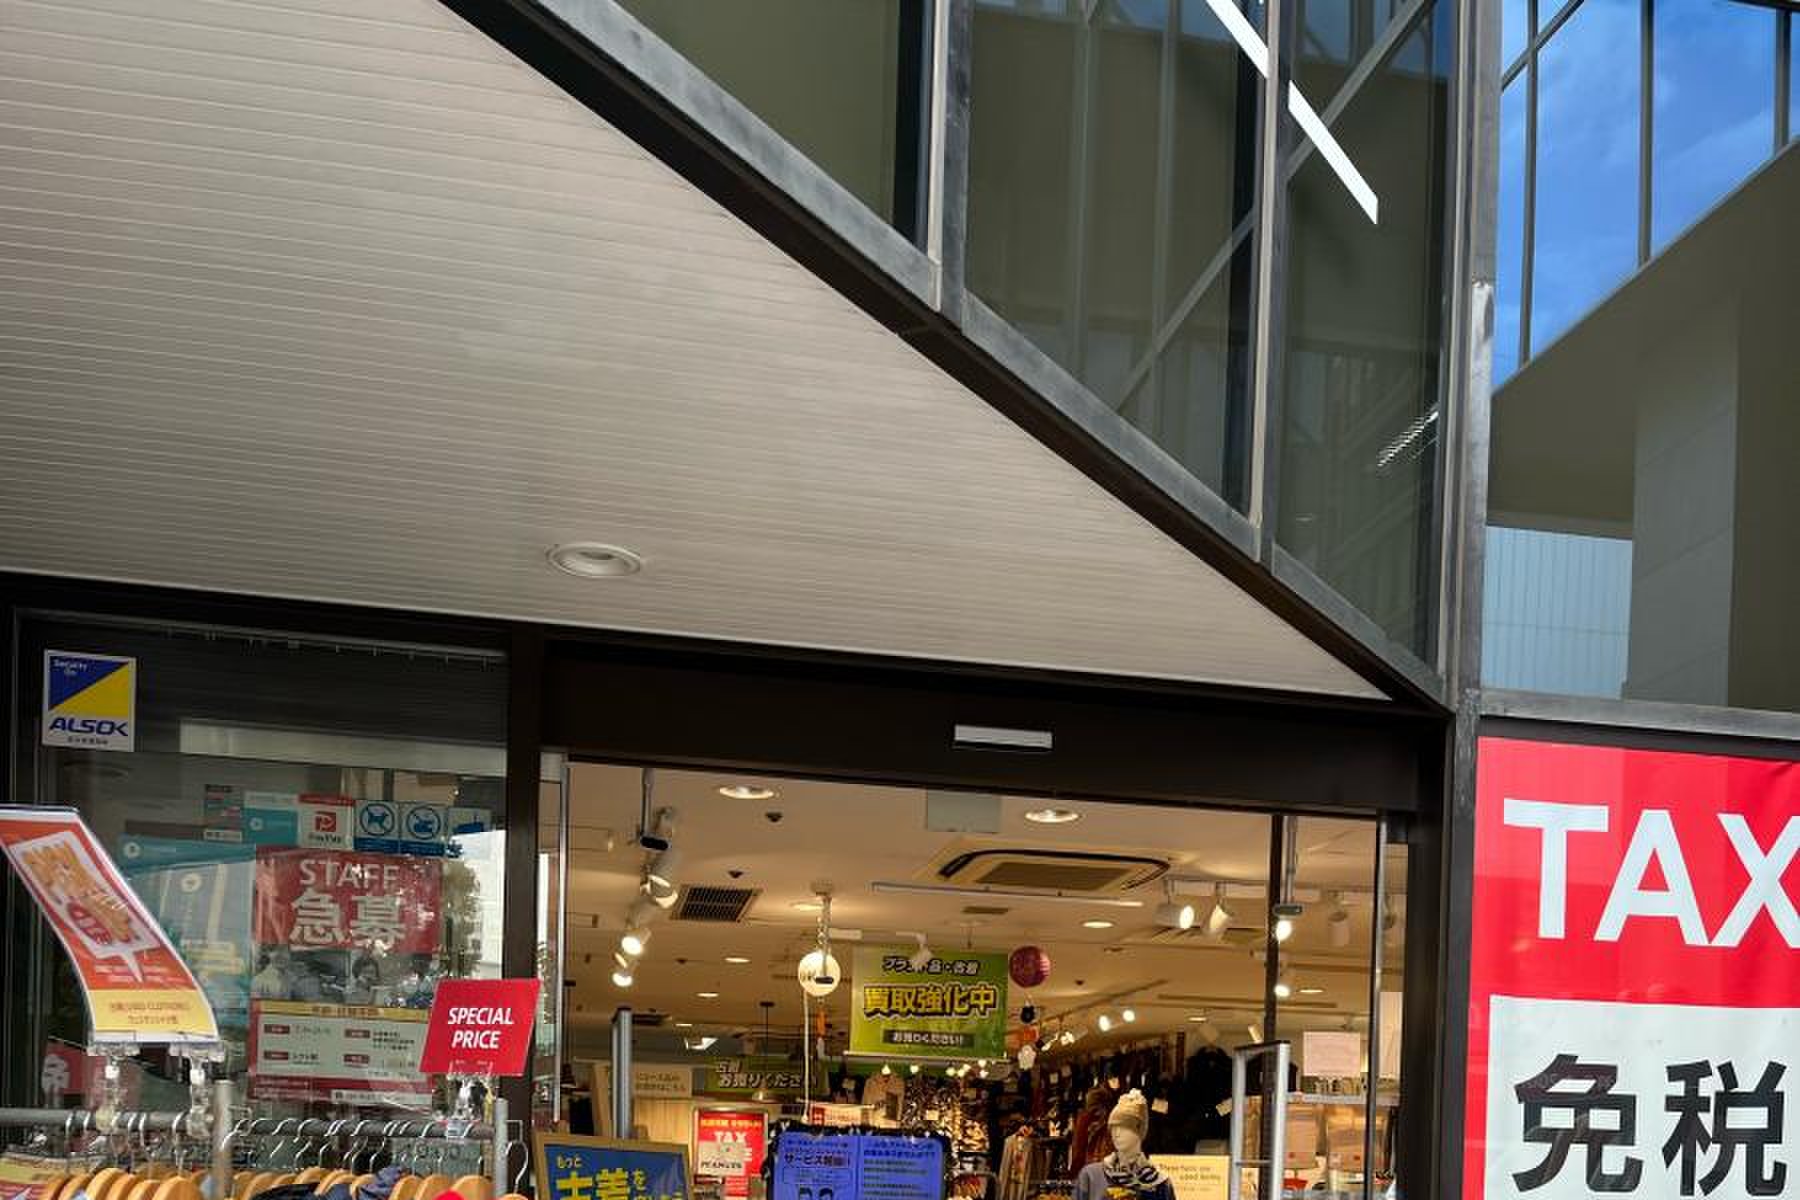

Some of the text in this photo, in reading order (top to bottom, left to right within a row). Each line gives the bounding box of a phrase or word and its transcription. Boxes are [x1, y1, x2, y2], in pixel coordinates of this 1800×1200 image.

[50, 717, 129, 737] ALSOK
[299, 857, 400, 889] STAFF
[1503, 798, 1800, 949] TAX
[289, 887, 406, 950] 急募
[447, 1007, 515, 1025] SPECIAL
[864, 985, 997, 1017] 買取強化中
[451, 1030, 502, 1049] PRICE
[1512, 1054, 1787, 1197] 免税
[556, 1153, 583, 1169] もっと
